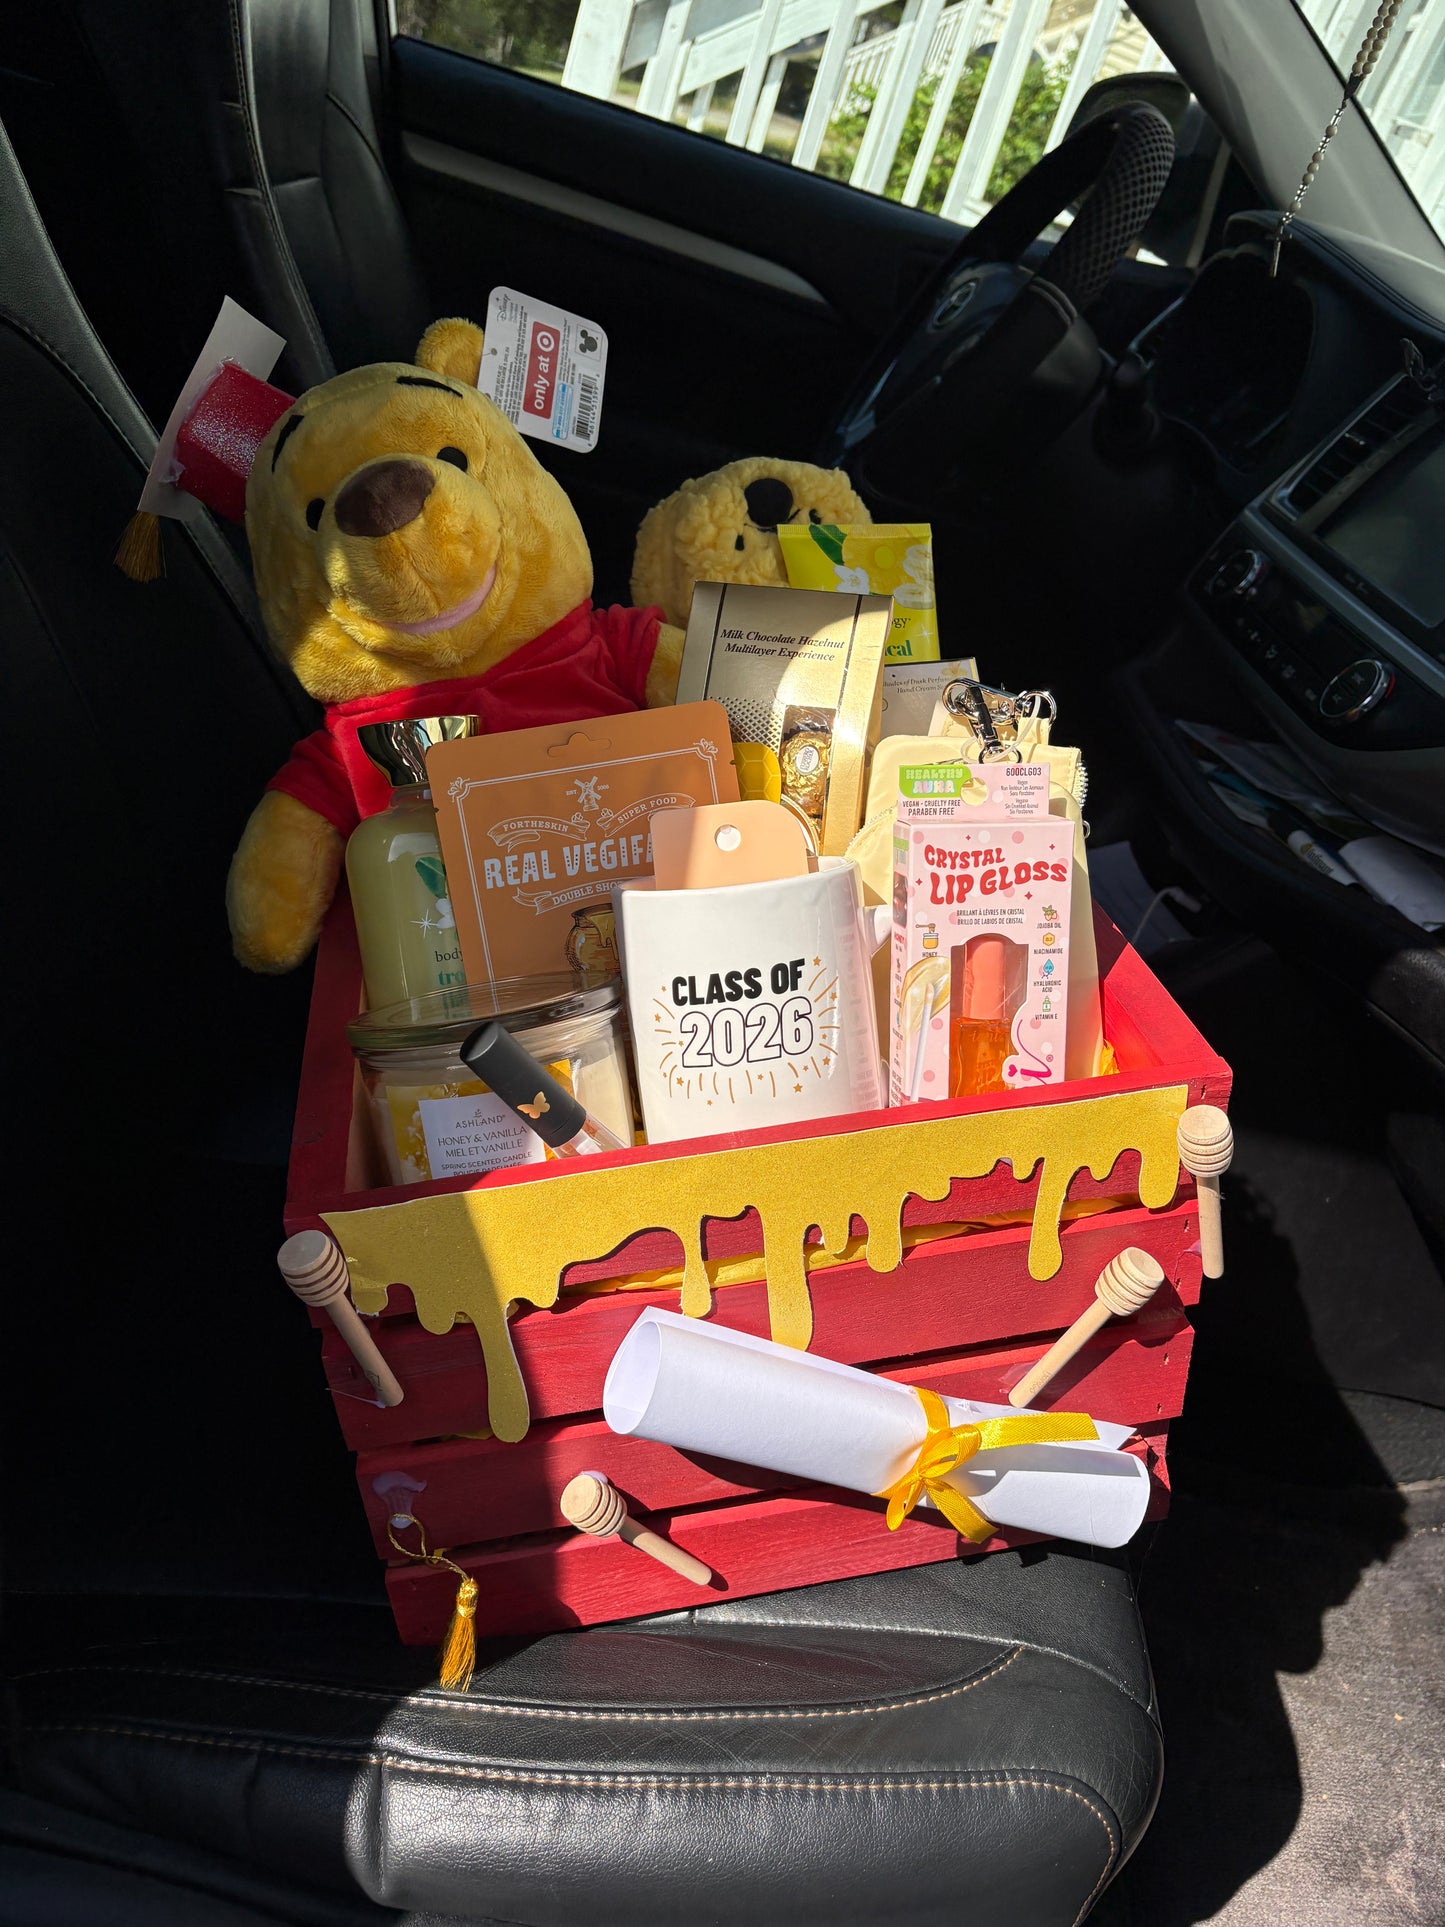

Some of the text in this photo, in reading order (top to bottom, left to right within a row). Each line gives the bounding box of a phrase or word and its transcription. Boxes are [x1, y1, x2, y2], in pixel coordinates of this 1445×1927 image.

[534, 355, 550, 410] only at
[891, 617, 909, 628] gy
[720, 629, 845, 649] Milk Chocolate Hazelnut
[724, 643, 835, 661] Multilayer Experience
[906, 768, 963, 780] HEALTHY
[912, 780, 955, 794] AURA
[618, 797, 677, 823] SUPER FOOD
[908, 807, 955, 816] PARABEN FREE
[503, 820, 569, 832] FORTHESKIN
[924, 844, 1005, 870] CRYSTAL
[484, 850, 556, 889] REAL
[552, 881, 624, 905] DOUBLE SHO
[930, 861, 1067, 905] LIP GLOSS
[671, 958, 805, 1006] CLASS OF
[680, 996, 814, 1069] 2026
[437, 1126, 528, 1147] HONEY & VANILLA
[445, 1139, 524, 1158] MIEL ET VANILLE
[467, 1157, 502, 1169] SCENTED
[502, 1151, 532, 1163] CANDLE
